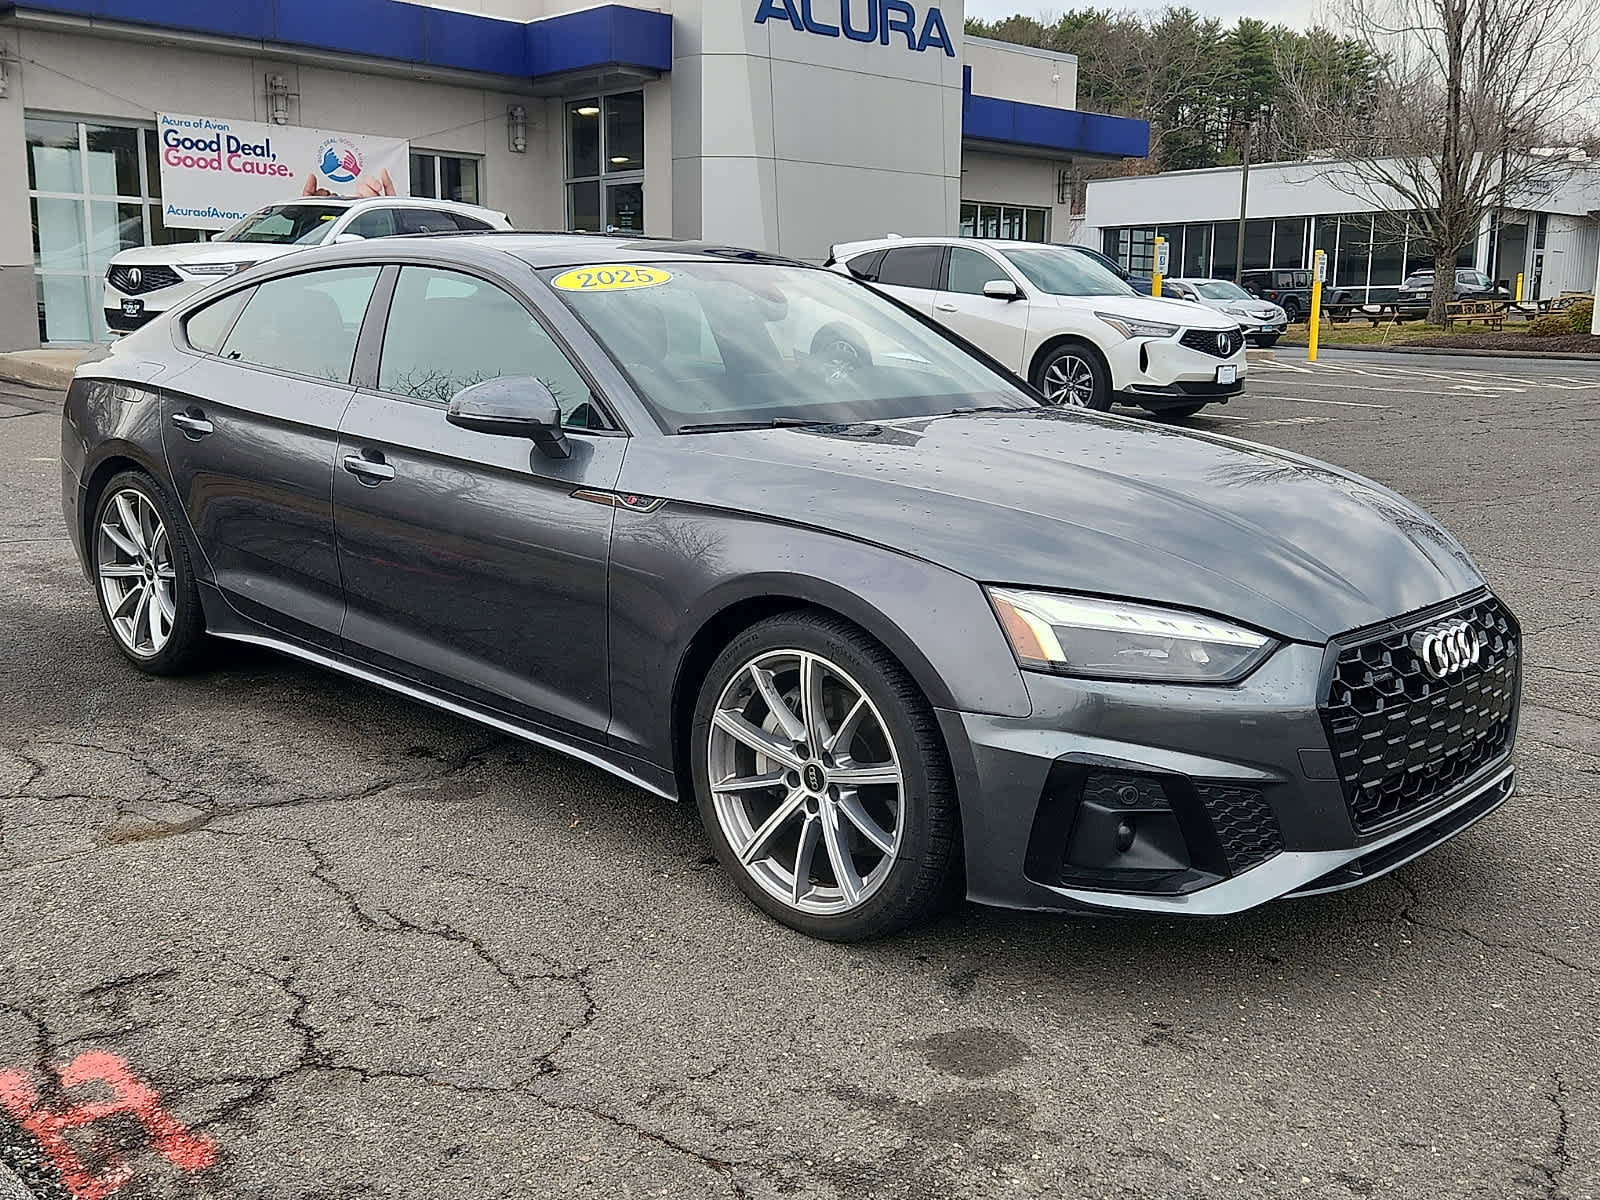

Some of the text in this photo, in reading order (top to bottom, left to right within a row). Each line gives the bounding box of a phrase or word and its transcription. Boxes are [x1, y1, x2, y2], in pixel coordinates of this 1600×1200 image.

[754, 0, 956, 57] ACURA
[161, 115, 230, 132] Acura of Avon
[163, 129, 276, 162] Good Deal,
[164, 147, 294, 178] Good Cause.
[577, 270, 653, 287] 2025
